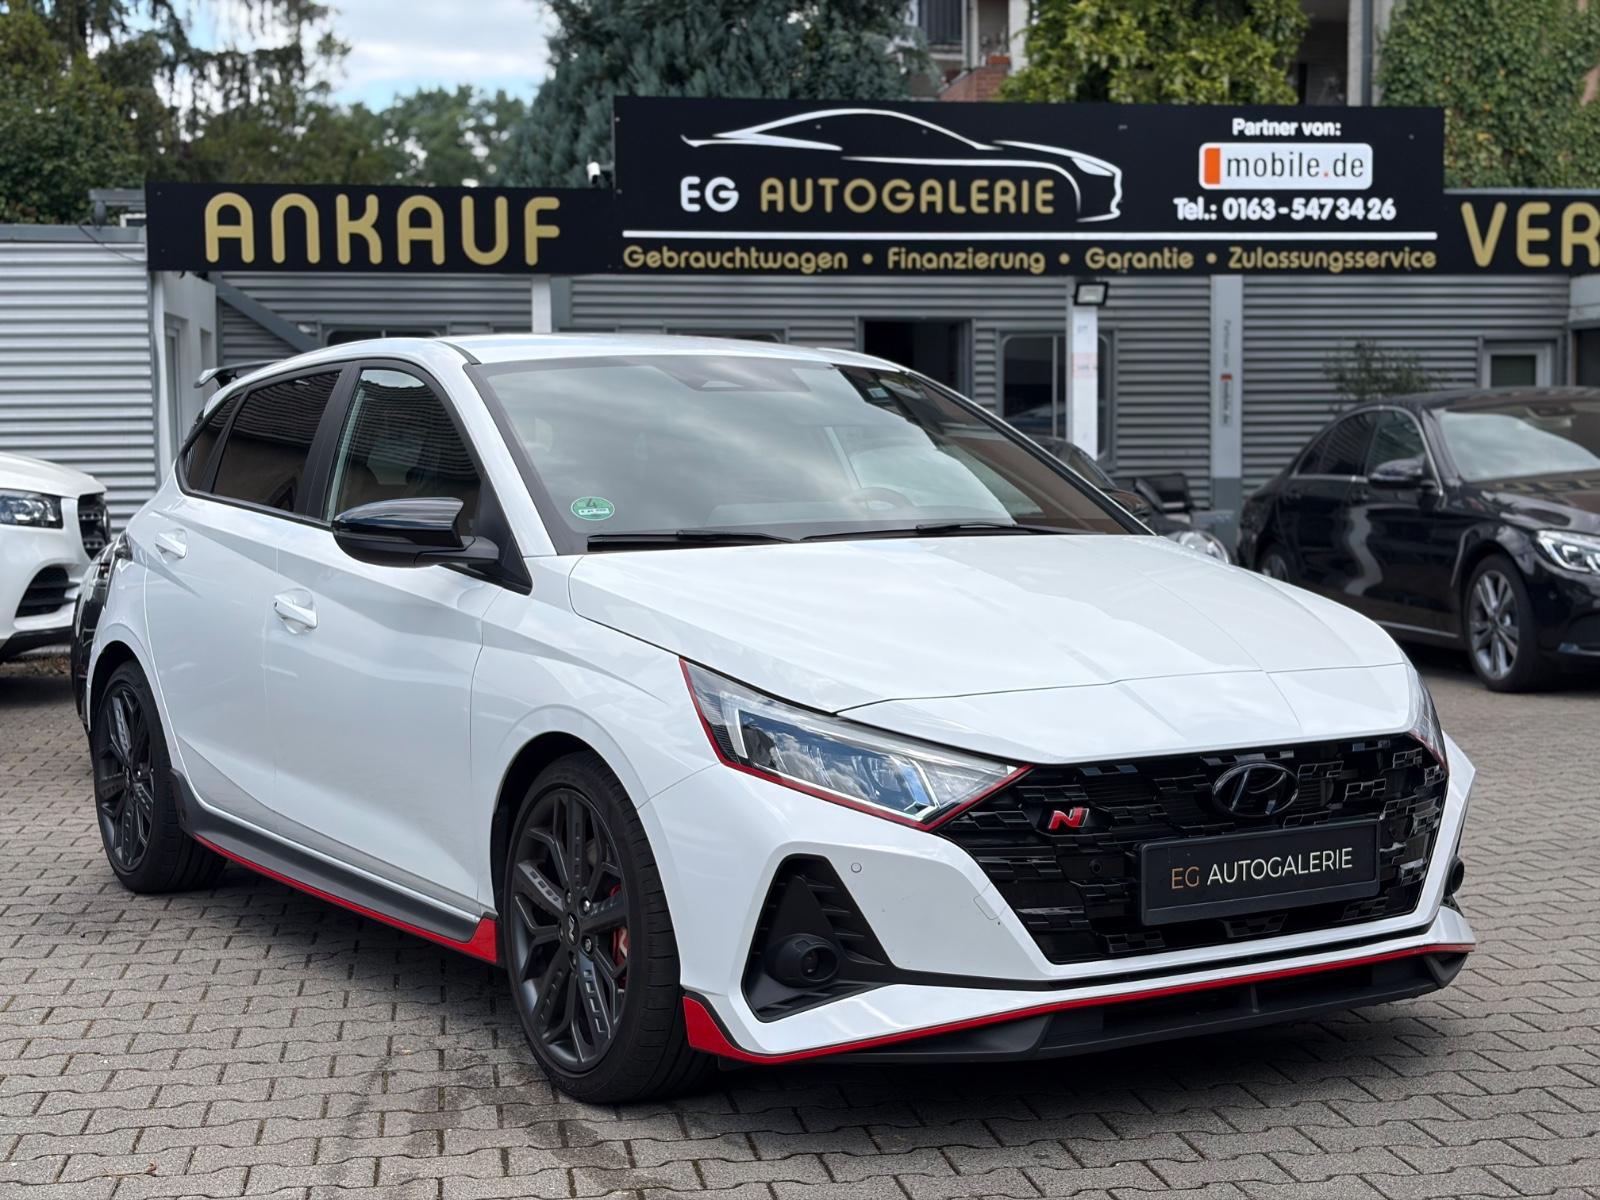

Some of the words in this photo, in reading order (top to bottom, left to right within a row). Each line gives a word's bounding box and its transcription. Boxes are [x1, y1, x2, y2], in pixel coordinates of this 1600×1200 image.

[1231, 117, 1298, 136] Partner
[1301, 121, 1342, 136] von:
[1226, 151, 1364, 177] mobile.de
[680, 176, 739, 212] EG
[760, 177, 1055, 213] AUTOGALERIE
[1173, 196, 1218, 220] Tel.:
[1222, 197, 1397, 220] 0163-5473426
[204, 191, 560, 266] ANKAUF
[1461, 201, 1600, 267] VER
[623, 245, 848, 272] Gebrauchtwagen
[887, 247, 1045, 273] Finanzierung
[1085, 247, 1194, 269] Garantie
[1228, 246, 1436, 273] Zulassungsservice
[1171, 866, 1199, 889] EG
[1207, 847, 1353, 886] AUTOGALERIE
